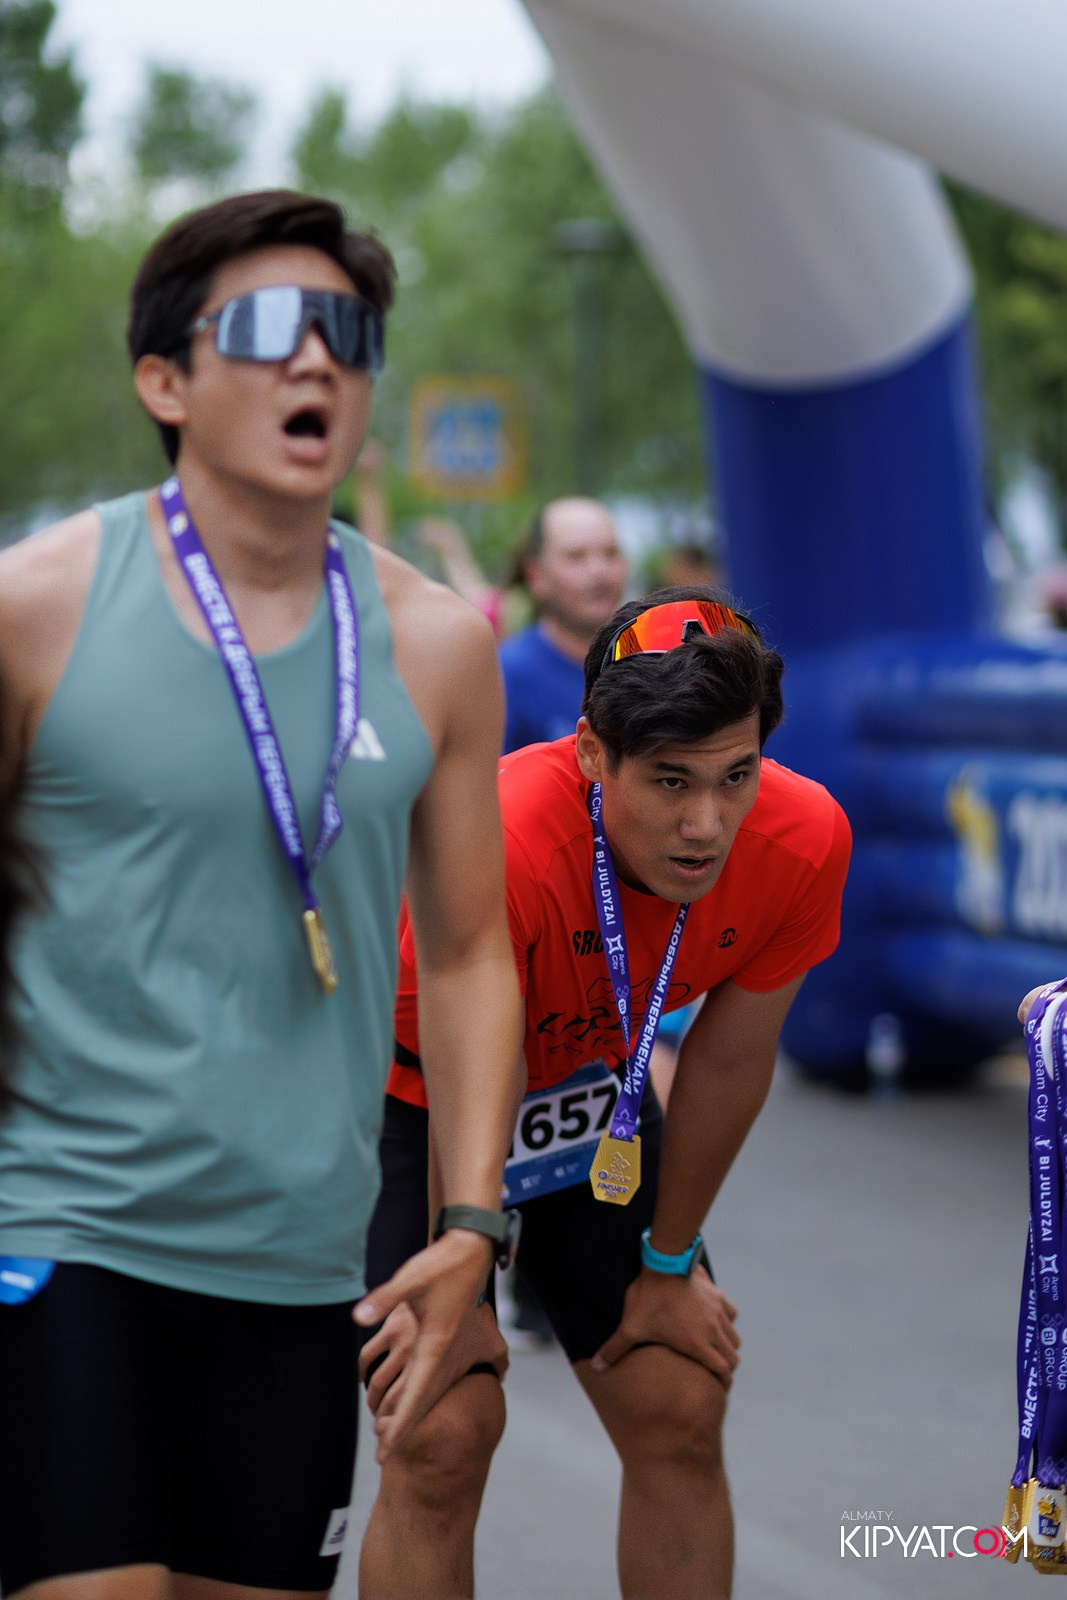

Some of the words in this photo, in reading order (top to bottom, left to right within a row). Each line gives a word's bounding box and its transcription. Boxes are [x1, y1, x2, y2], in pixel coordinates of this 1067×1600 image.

[184, 552, 234, 626] ВМЕСТЕ
[590, 797, 602, 821] City
[595, 851, 605, 863] BI
[597, 867, 616, 925] JULDYZAI
[656, 921, 682, 994] ДОБРЫМ
[632, 995, 662, 1093] ПЕРЕМЕНАМ
[508, 1082, 618, 1158] 657
[1035, 1094, 1049, 1122] City
[1039, 1156, 1050, 1170] BI
[1040, 1174, 1053, 1241] JULDYZAI
